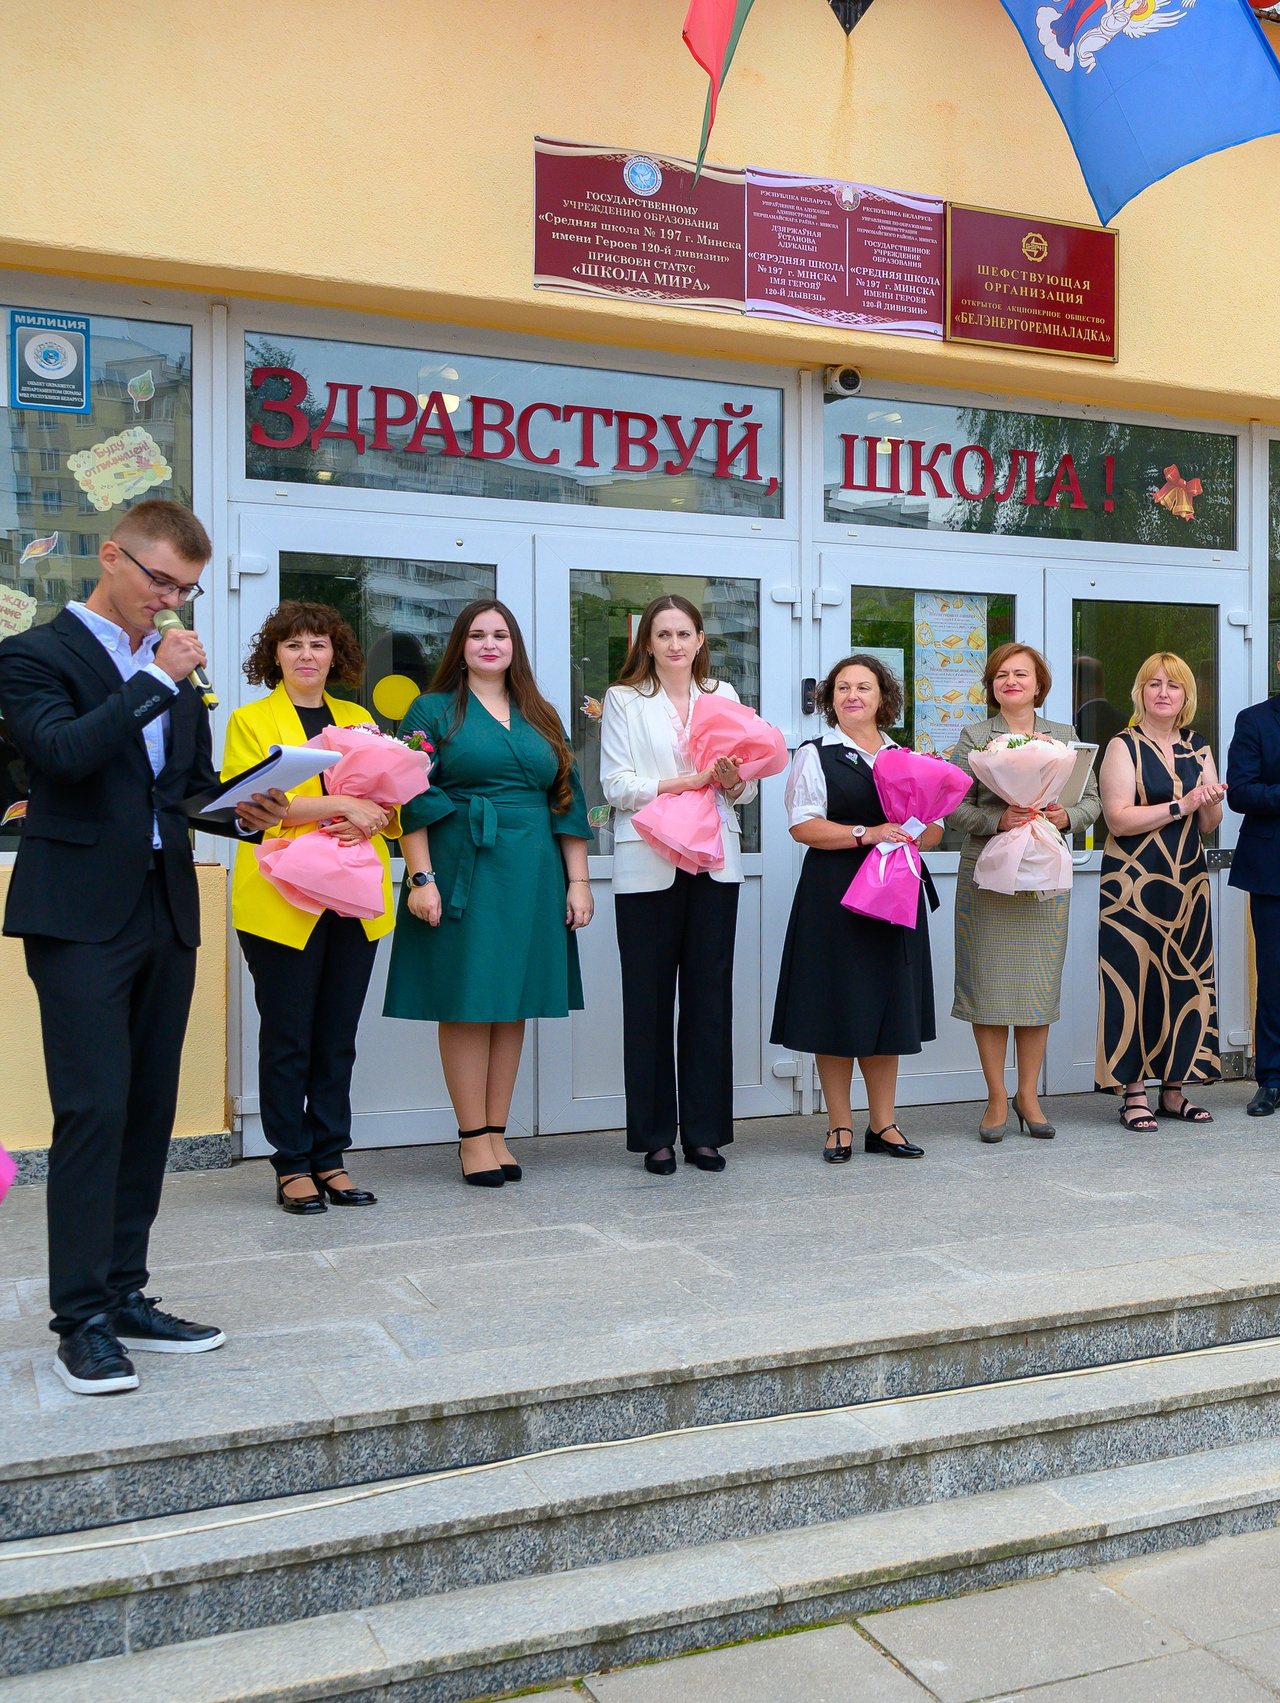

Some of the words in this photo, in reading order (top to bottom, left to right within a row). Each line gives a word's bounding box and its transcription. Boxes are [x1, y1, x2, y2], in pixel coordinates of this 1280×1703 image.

[586, 191, 698, 215] ГОСУДАРСТВЕННОМУ
[760, 190, 799, 201] РЭСПУБЛІКА
[801, 196, 832, 206] БЕЛАРУСЬ
[563, 199, 641, 218] УЧРЕЖДЕНИЮ
[644, 212, 720, 230] ОБРАЗОВАНИЯ
[863, 206, 901, 217] РЕСПУБЛИКА
[902, 213, 932, 221] БЕЛАРУСЬ
[539, 212, 597, 230] «Средняя
[601, 220, 640, 236] школа
[644, 226, 656, 238] №
[660, 228, 682, 241] 197
[685, 234, 693, 243] г.
[697, 234, 742, 250] Минска
[772, 225, 821, 237] ДЗЯРЖАЎНАЯ
[552, 231, 591, 244] имени
[595, 235, 638, 250] Героев
[641, 241, 671, 256] 120-й
[675, 248, 730, 263] дивизии»
[778, 241, 817, 252] АДУКАЦЫІ
[864, 240, 930, 255] ГОСУДАРСТВЕННОЕ
[874, 249, 921, 260] УЧРЕЖДЕНИЕ
[588, 251, 650, 267] ПРИСВОЕН
[654, 259, 695, 273] СТАТУС
[748, 252, 805, 266] «СЯРЭДНЯЯ
[808, 259, 845, 272] ШКОЛА
[872, 256, 922, 268] ОБРАЗОВАНИЯ
[572, 263, 649, 284] «ШКОЛА
[654, 272, 711, 291] МИРА»
[769, 266, 783, 274] 197
[797, 270, 837, 282] МІНСКА
[850, 266, 902, 280] «СРЕДНЯЯ
[904, 273, 941, 286] ШКОЛА
[977, 264, 1091, 290] ШЕФСТВУЮЩАЯ
[770, 277, 786, 285] ІМЯ
[788, 279, 821, 290] ГЕРОЯЎ
[867, 280, 880, 288] 197
[894, 283, 935, 296] МИНСКА
[765, 288, 785, 296] 120-Й
[787, 290, 826, 301] ДЫВІЗІІ»
[864, 290, 893, 299] ИМЕНИ
[895, 294, 926, 304] ГЕРОЕВ
[984, 281, 1084, 305] ОРГАНИЗАЦИЯ
[862, 300, 882, 309] 120-Й
[884, 303, 928, 315] ДИВИЗИИ»
[961, 298, 1002, 311] ОТКРЫТОЕ
[1006, 305, 1061, 319] АКЦИОНЕРНОЕ
[1065, 314, 1105, 324] ОБЩЕСТВО
[14, 314, 86, 330] МИЛИЦИЯ
[955, 312, 1111, 343] «БЕЛЭНЕРГОРЕМНАЛАДКА»
[251, 366, 778, 496] ЗДРАВСТВУЙ,
[94, 440, 125, 458] Буду
[84, 440, 150, 477] отличницей!
[2, 594, 29, 610] жду
